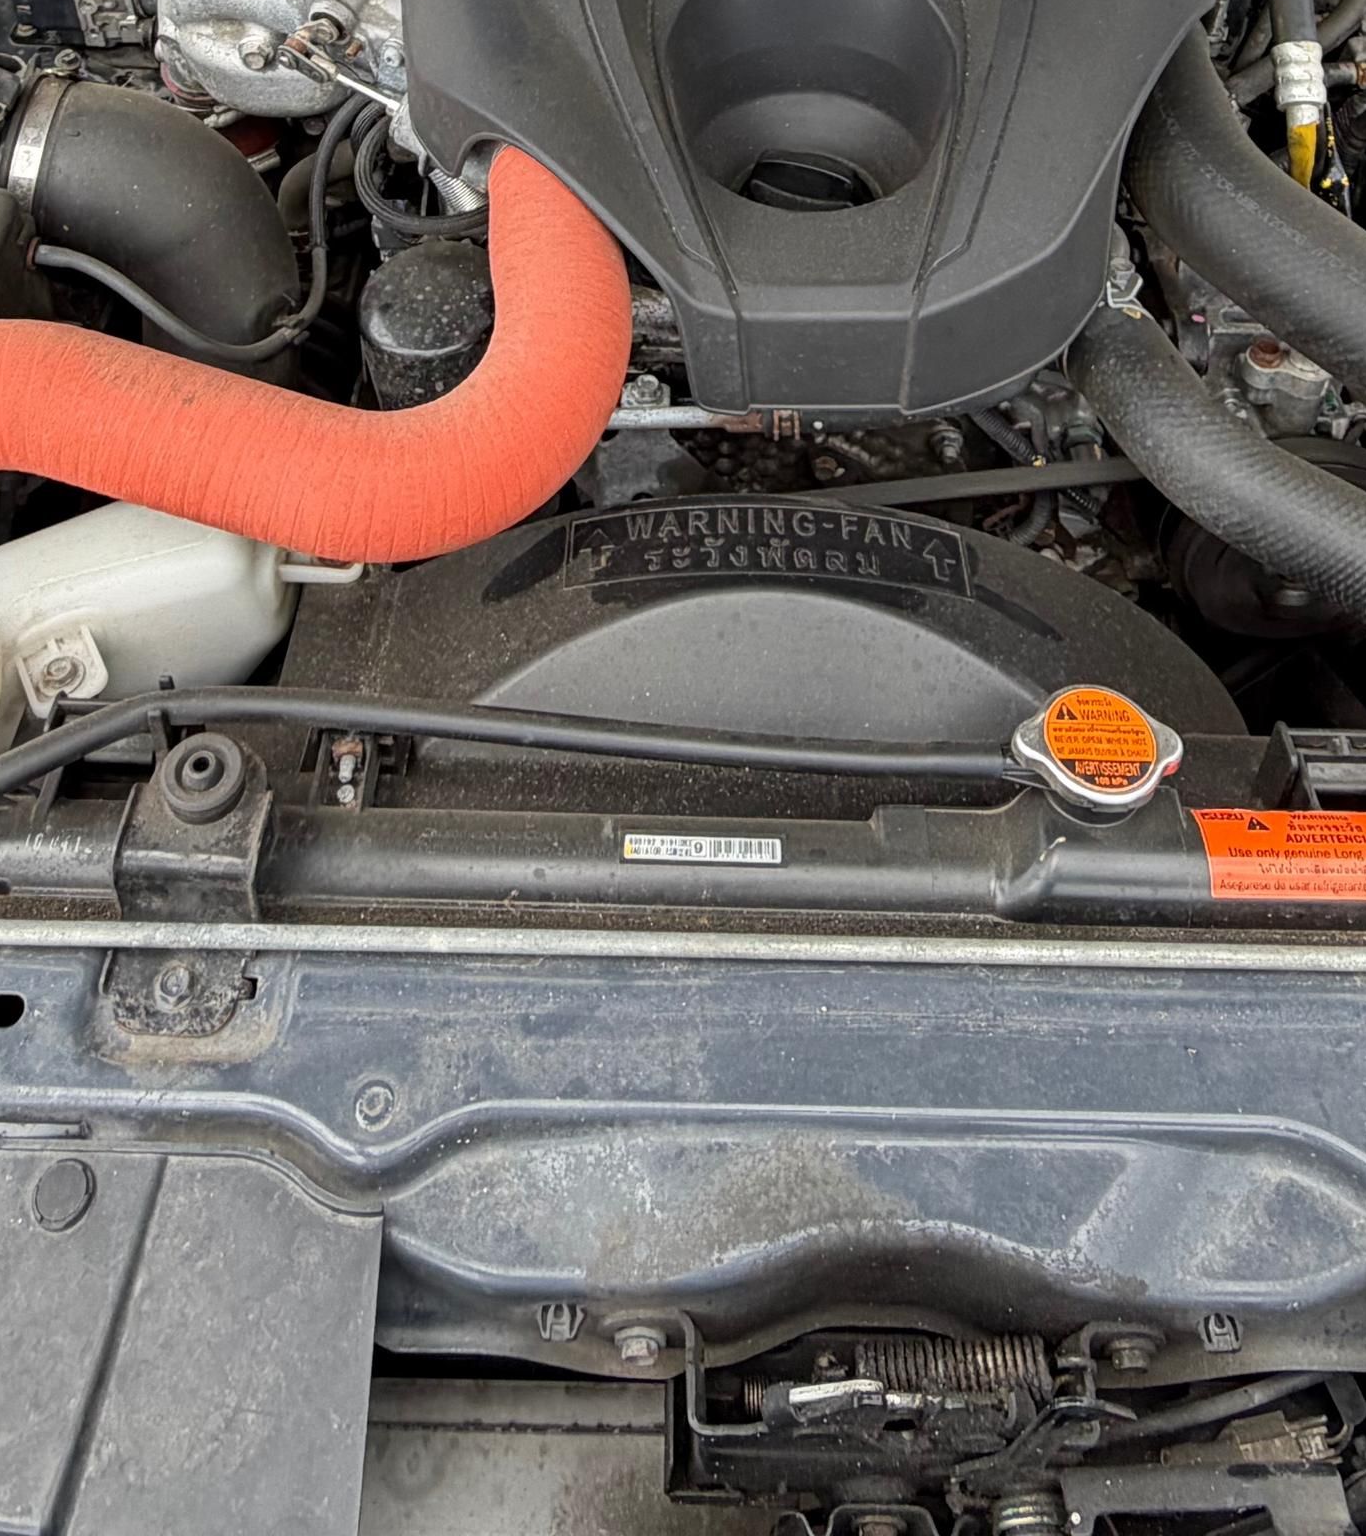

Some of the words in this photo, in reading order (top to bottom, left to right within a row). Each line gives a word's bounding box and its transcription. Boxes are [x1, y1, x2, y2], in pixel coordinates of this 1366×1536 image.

[626, 507, 912, 551] WARNING-FAN
[1079, 710, 1130, 721] WARNING
[1055, 735, 1079, 744] NEVER
[1082, 736, 1102, 744] OPEN
[1075, 761, 1140, 776] AVERTISSEMENT
[1201, 812, 1244, 821] ISUZU
[1228, 847, 1252, 858] Use
[1256, 848, 1281, 860] only
[1284, 848, 1331, 861] genuine
[1334, 848, 1364, 861] Long
[1274, 880, 1286, 891] de
[1289, 881, 1310, 891] usar
